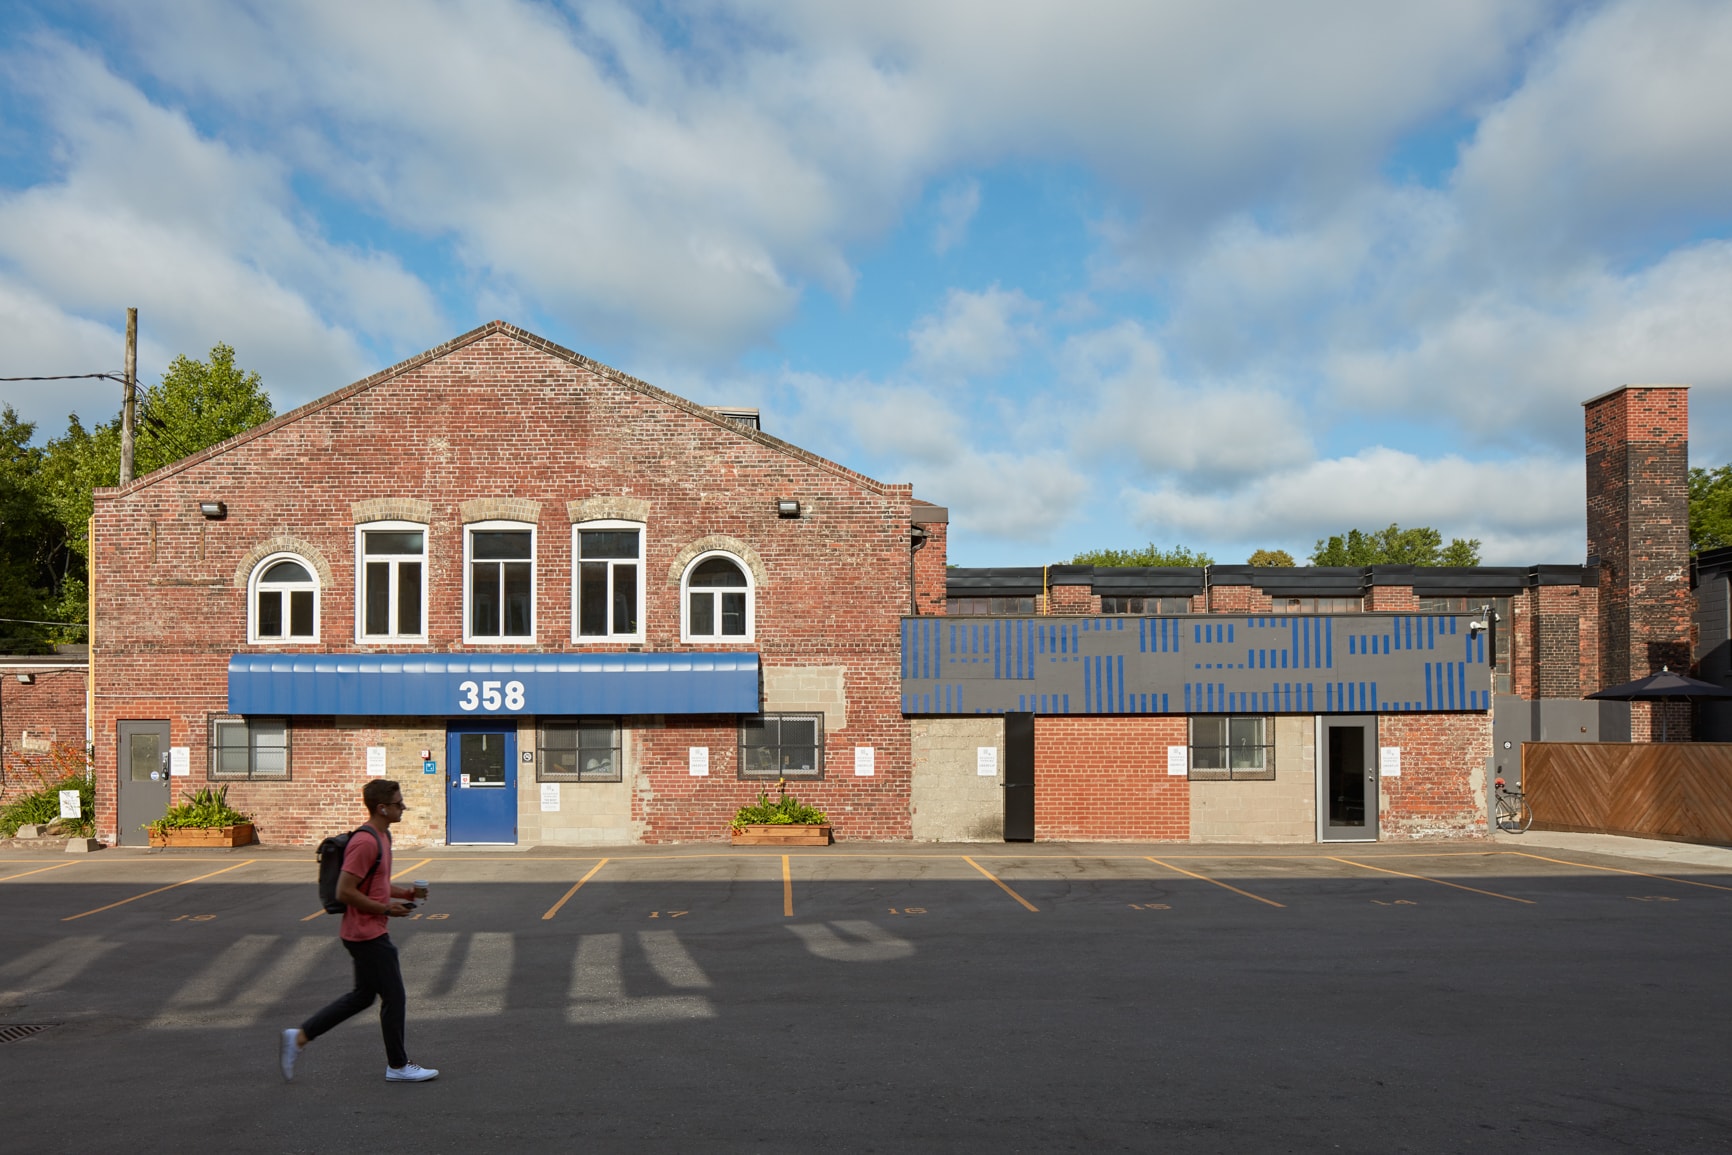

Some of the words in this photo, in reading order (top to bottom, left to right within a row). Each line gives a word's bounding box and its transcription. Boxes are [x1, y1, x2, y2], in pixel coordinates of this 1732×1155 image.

[459, 680, 525, 712] 358
[169, 913, 217, 922] 19
[648, 911, 689, 919] 17
